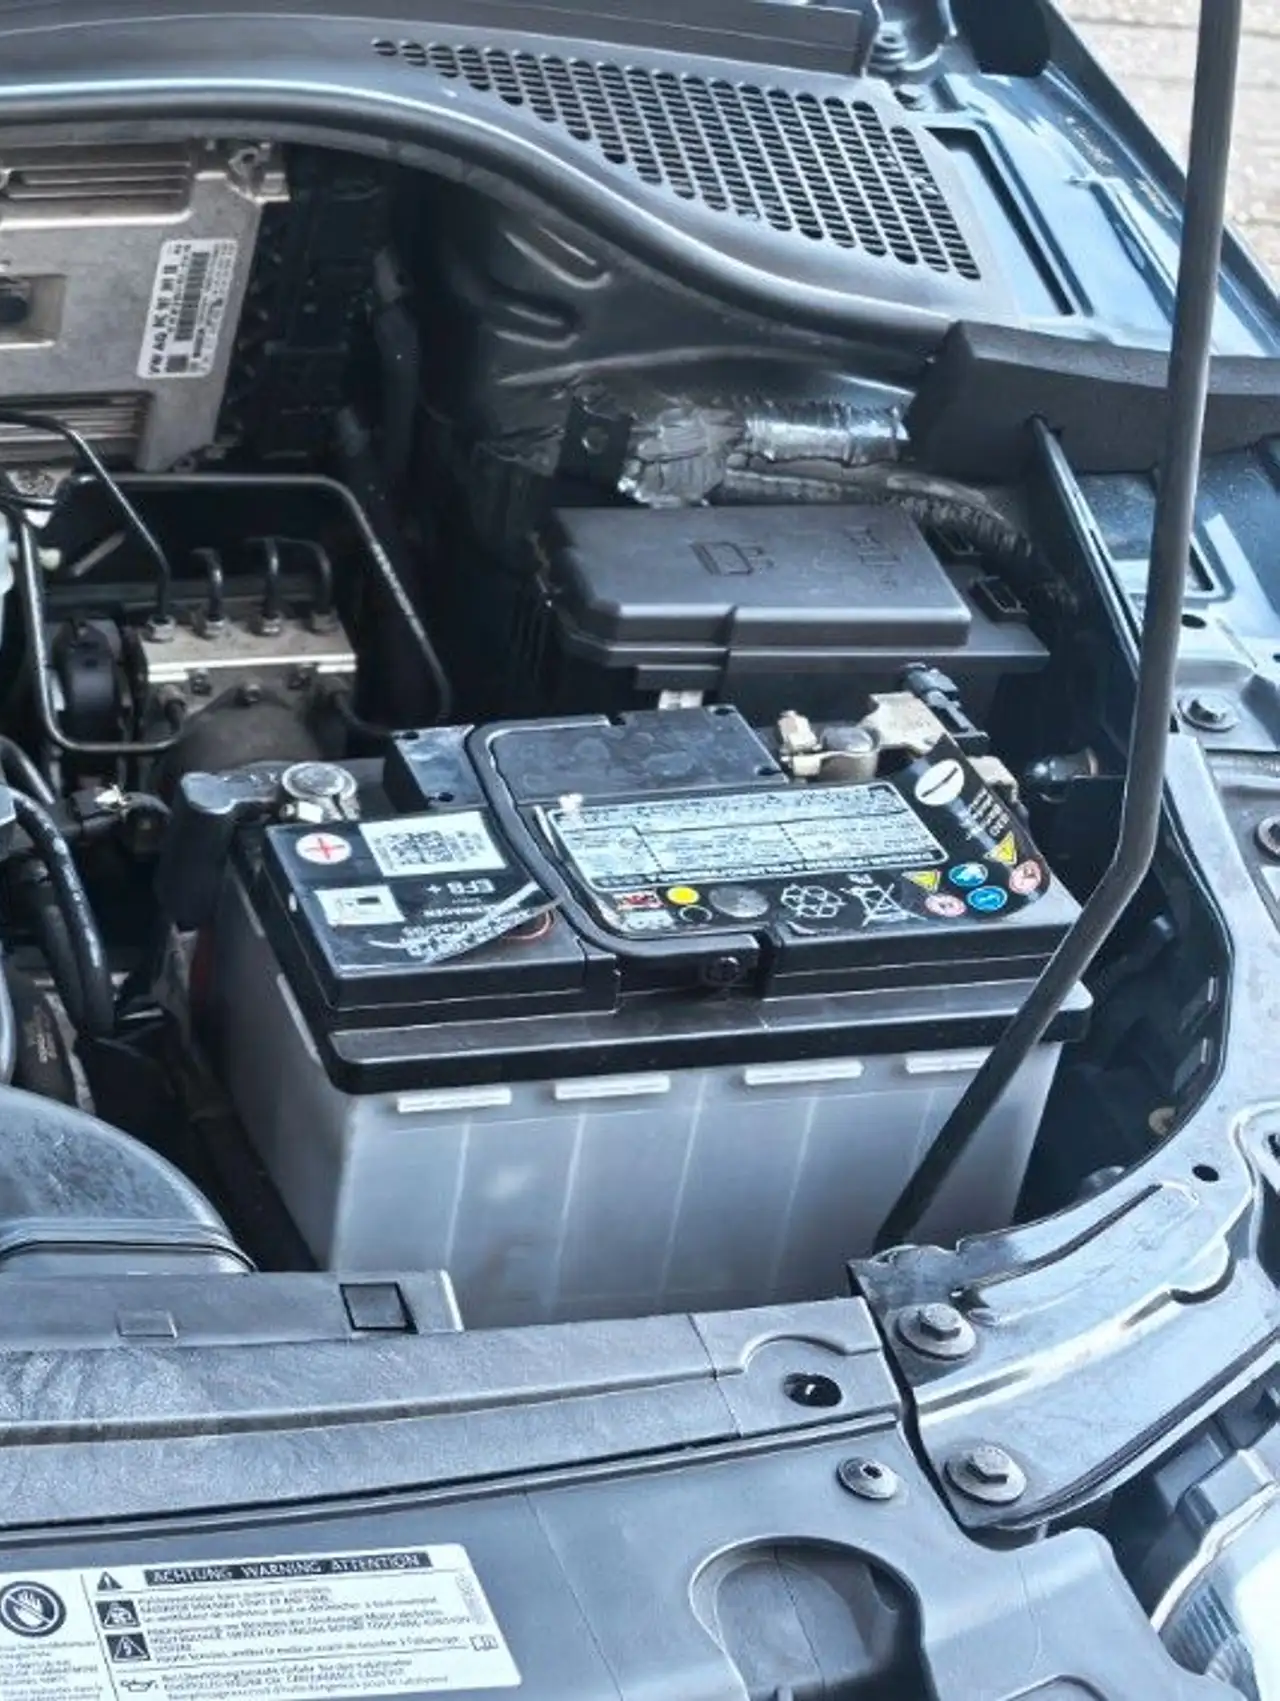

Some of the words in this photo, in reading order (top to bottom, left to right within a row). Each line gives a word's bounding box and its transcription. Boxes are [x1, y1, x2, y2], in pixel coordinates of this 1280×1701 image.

[153, 1567, 233, 1583] ACHTUNG
[240, 1560, 322, 1578] WARNING
[331, 1554, 420, 1572] ATTENTION
